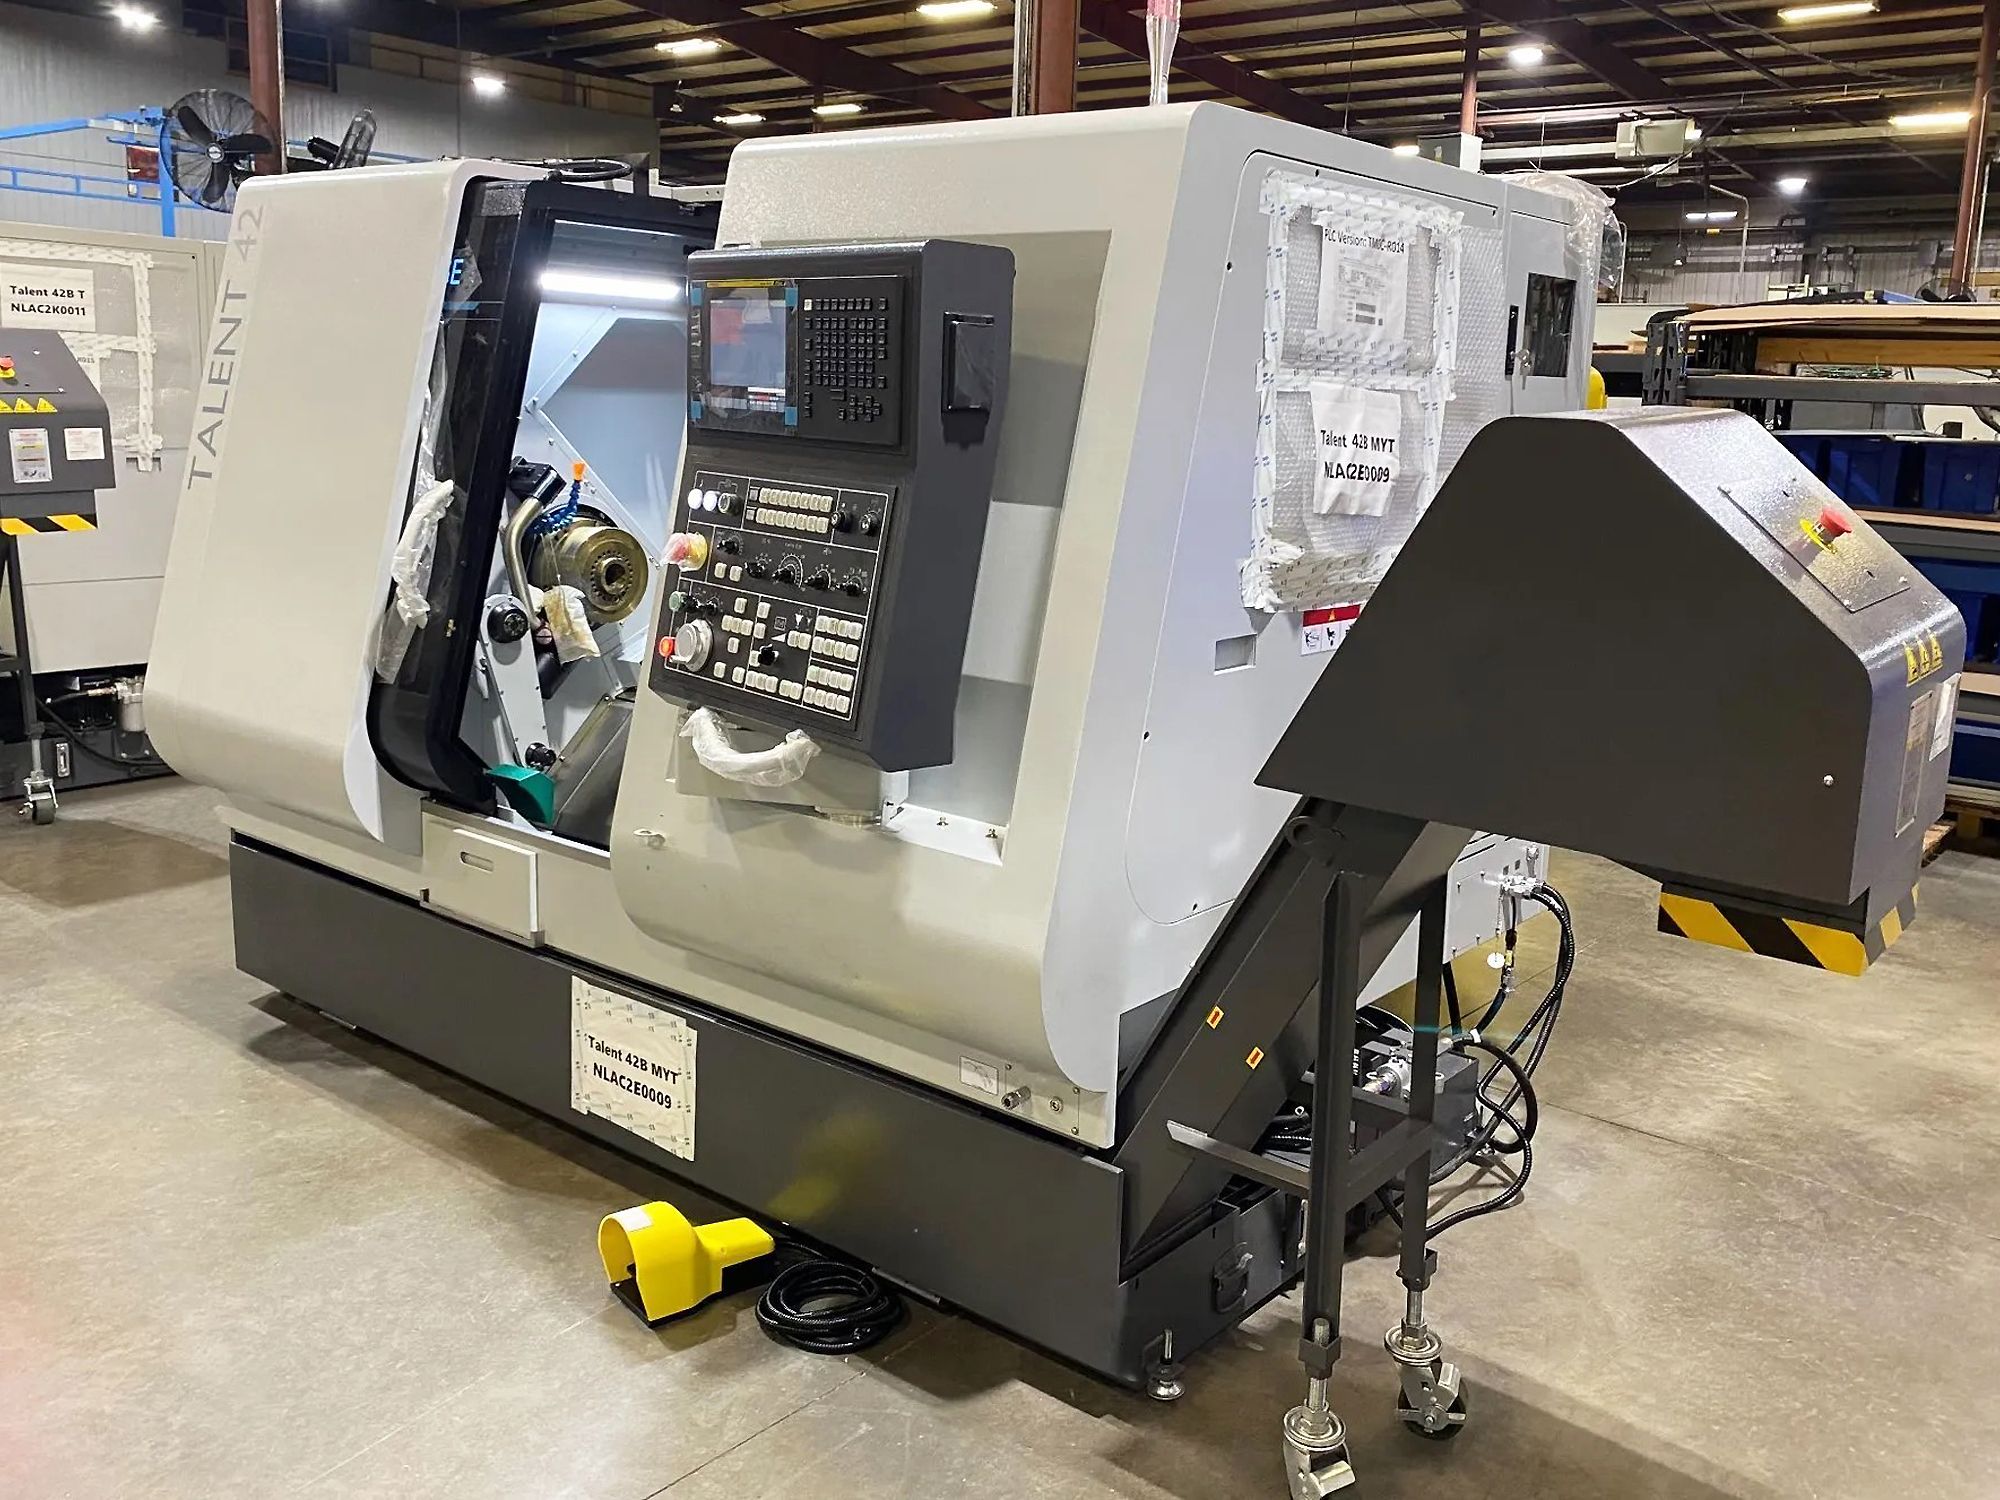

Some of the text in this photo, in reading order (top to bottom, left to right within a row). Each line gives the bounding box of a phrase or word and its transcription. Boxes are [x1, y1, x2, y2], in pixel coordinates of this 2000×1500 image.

[1324, 228, 1336, 242] PLC
[9, 285, 86, 299] Talent 42B T
[11, 302, 86, 316] NLAC2K0011
[188, 205, 263, 490] TALENT 42
[1320, 429, 1396, 453] Talent 42B MYT
[1324, 461, 1390, 483] NLAC2E0009
[587, 1034, 679, 1085] Talent 42B MYT
[593, 1062, 672, 1110] NLAC2E0009
